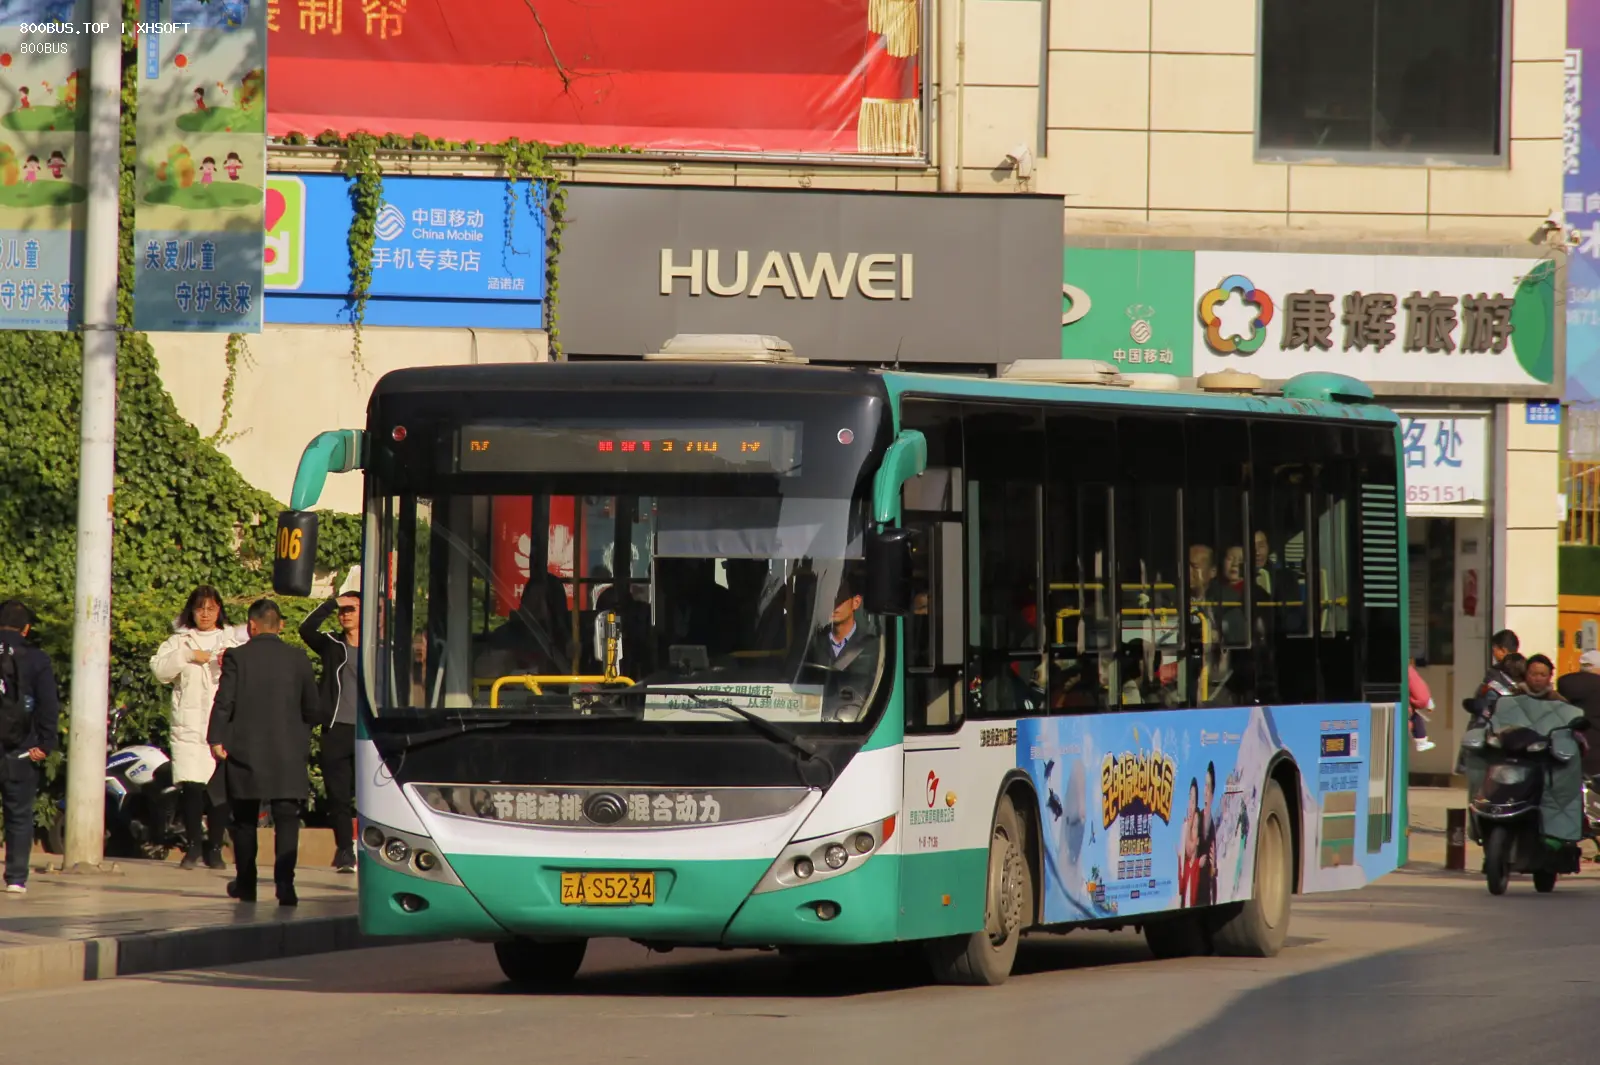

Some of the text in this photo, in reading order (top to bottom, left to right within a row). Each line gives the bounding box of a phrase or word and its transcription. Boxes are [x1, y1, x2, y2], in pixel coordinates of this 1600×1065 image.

[412, 208, 484, 228] 中国移动
[412, 229, 483, 242] China Mobile
[0, 239, 40, 270] 儿童
[145, 240, 216, 271] 关爱儿童
[371, 247, 481, 272] 手机专卖店
[659, 248, 913, 300] HUAWEI
[0, 280, 75, 312] 守护未来
[175, 281, 253, 314] 守护未来
[1280, 289, 1516, 355] 康辉旅游
[1113, 348, 1173, 364] 中国移动
[1402, 418, 1463, 468] 名处
[277, 527, 303, 560] 06
[494, 792, 721, 822] 节能减排 混合动力
